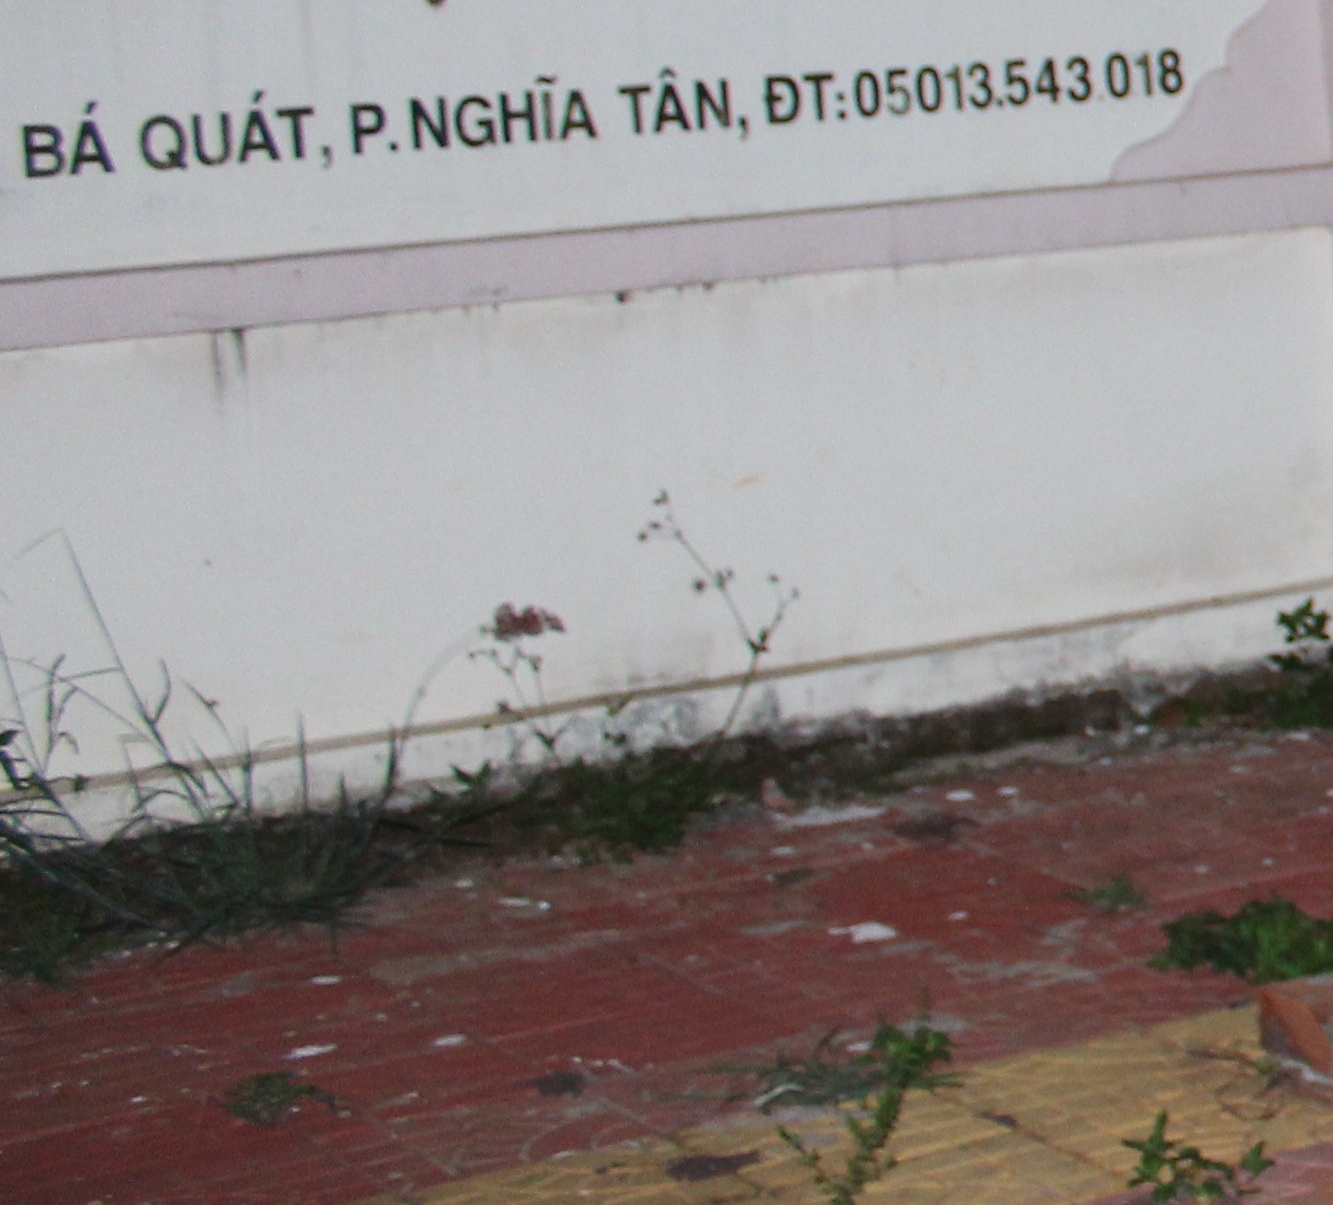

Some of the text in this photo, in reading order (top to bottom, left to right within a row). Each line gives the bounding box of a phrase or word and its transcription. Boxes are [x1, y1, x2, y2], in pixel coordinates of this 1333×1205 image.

[22, 100, 116, 179] BÁ
[139, 90, 333, 172] QUÁT,
[618, 67, 750, 140] TÂN,
